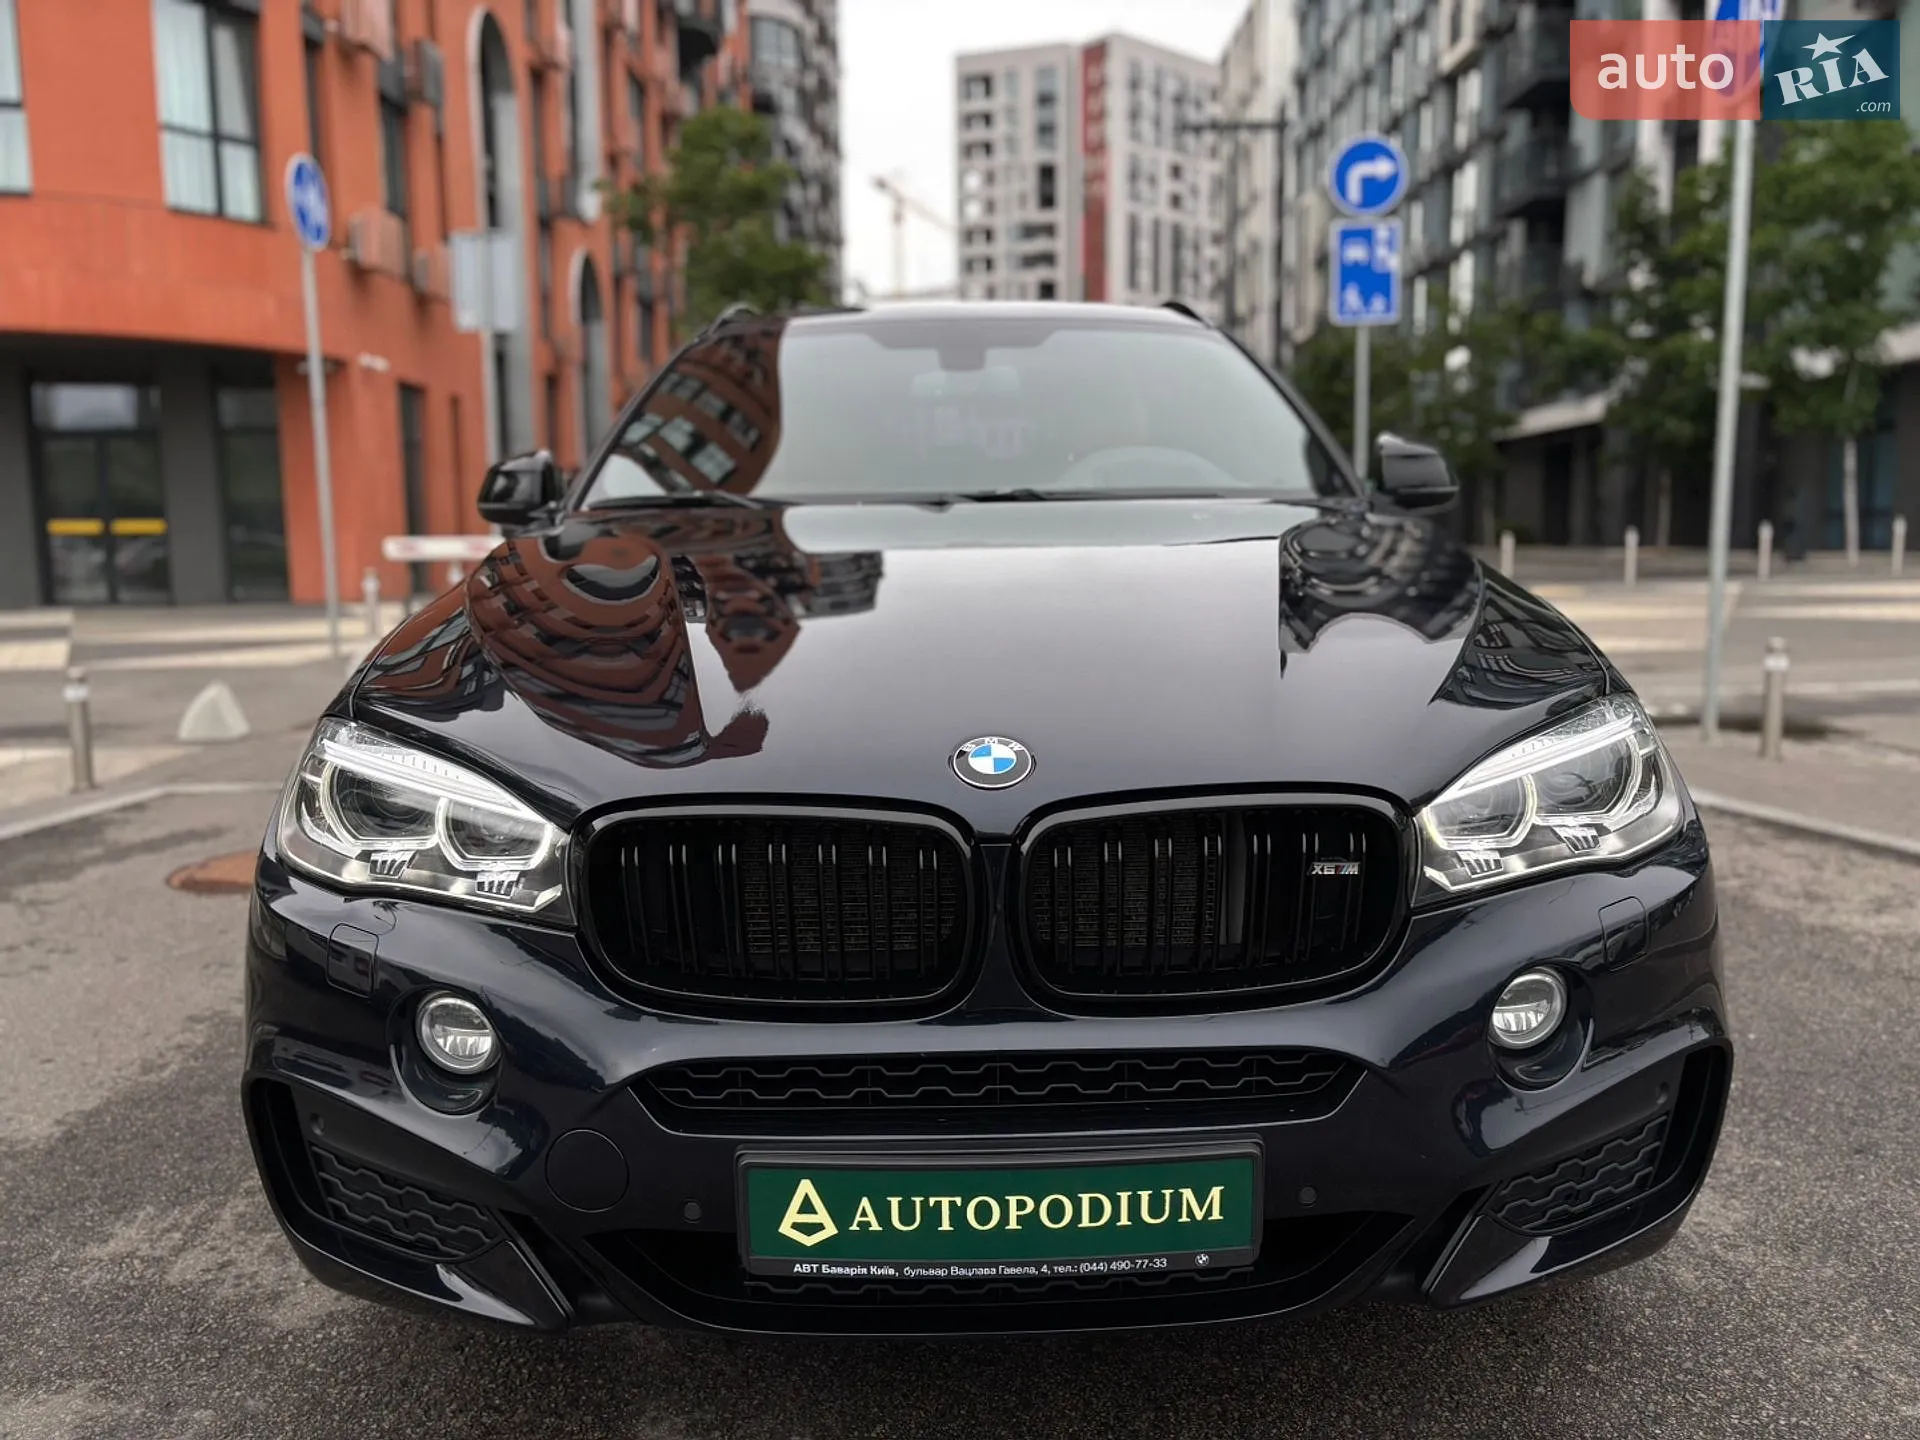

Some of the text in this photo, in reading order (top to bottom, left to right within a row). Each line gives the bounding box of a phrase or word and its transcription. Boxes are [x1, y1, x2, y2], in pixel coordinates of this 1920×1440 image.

[848, 1186, 1225, 1232] AUTOPODIUM
[793, 1263, 820, 1274] АВТ
[821, 1264, 868, 1276] Баварія
[903, 1266, 948, 1277] бульвар
[950, 1265, 997, 1277] Вацлава
[999, 1264, 1038, 1275] Гавела,
[1041, 1264, 1051, 1274] 4,
[1053, 1263, 1078, 1274] тел.:
[1079, 1261, 1108, 1273] (044)
[1110, 1257, 1168, 1271] 490-77-33
